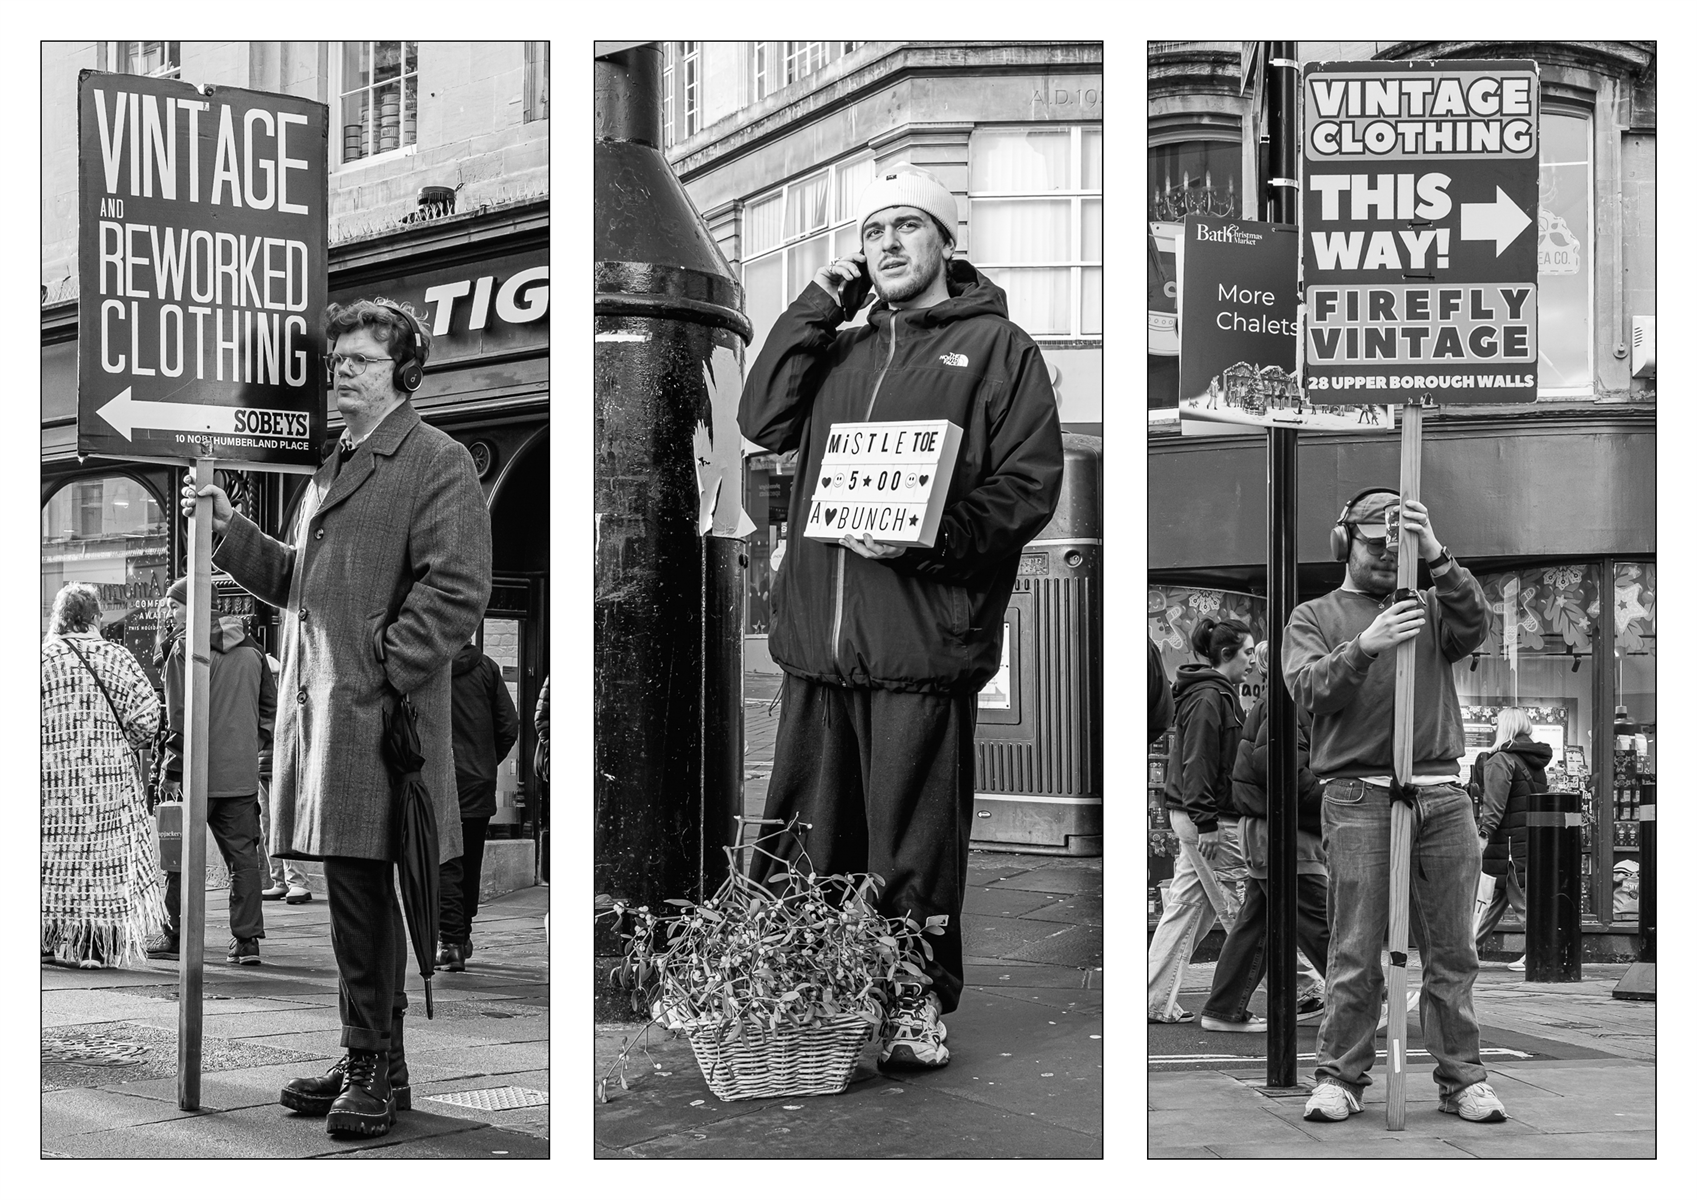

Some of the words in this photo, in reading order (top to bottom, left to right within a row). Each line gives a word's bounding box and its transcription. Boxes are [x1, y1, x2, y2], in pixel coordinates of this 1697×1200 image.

[1309, 77, 1532, 118] VINTAGE
[1310, 118, 1533, 156] CLOTHING
[94, 89, 309, 215] VINTAGE
[100, 198, 124, 219] AND
[1310, 172, 1453, 220] THIS
[1197, 223, 1233, 243] Bath
[1234, 238, 1256, 246] Market
[1310, 228, 1451, 270] WAY!
[1538, 251, 1551, 265] EA
[1554, 251, 1571, 265] CO.
[99, 220, 309, 312] REWORKED
[425, 266, 549, 336] TIG
[1218, 283, 1276, 306] More
[1313, 288, 1533, 323] FIREFLY
[1216, 311, 1298, 336] Chalets
[101, 299, 307, 387] CLOTHING
[1309, 324, 1530, 360] VINTAGE
[1308, 376, 1330, 389] 28
[1331, 376, 1388, 389] UPPER
[1389, 375, 1476, 389] BOROUGH
[1477, 374, 1535, 388] WALLS
[234, 409, 308, 437] SOBEYS
[175, 434, 186, 443] 10
[187, 434, 278, 449] NORTHUMBERLAND
[279, 440, 310, 451] PLACE
[810, 502, 822, 524] A
[837, 506, 907, 531] BUNCH
[135, 599, 165, 608] COMFO
